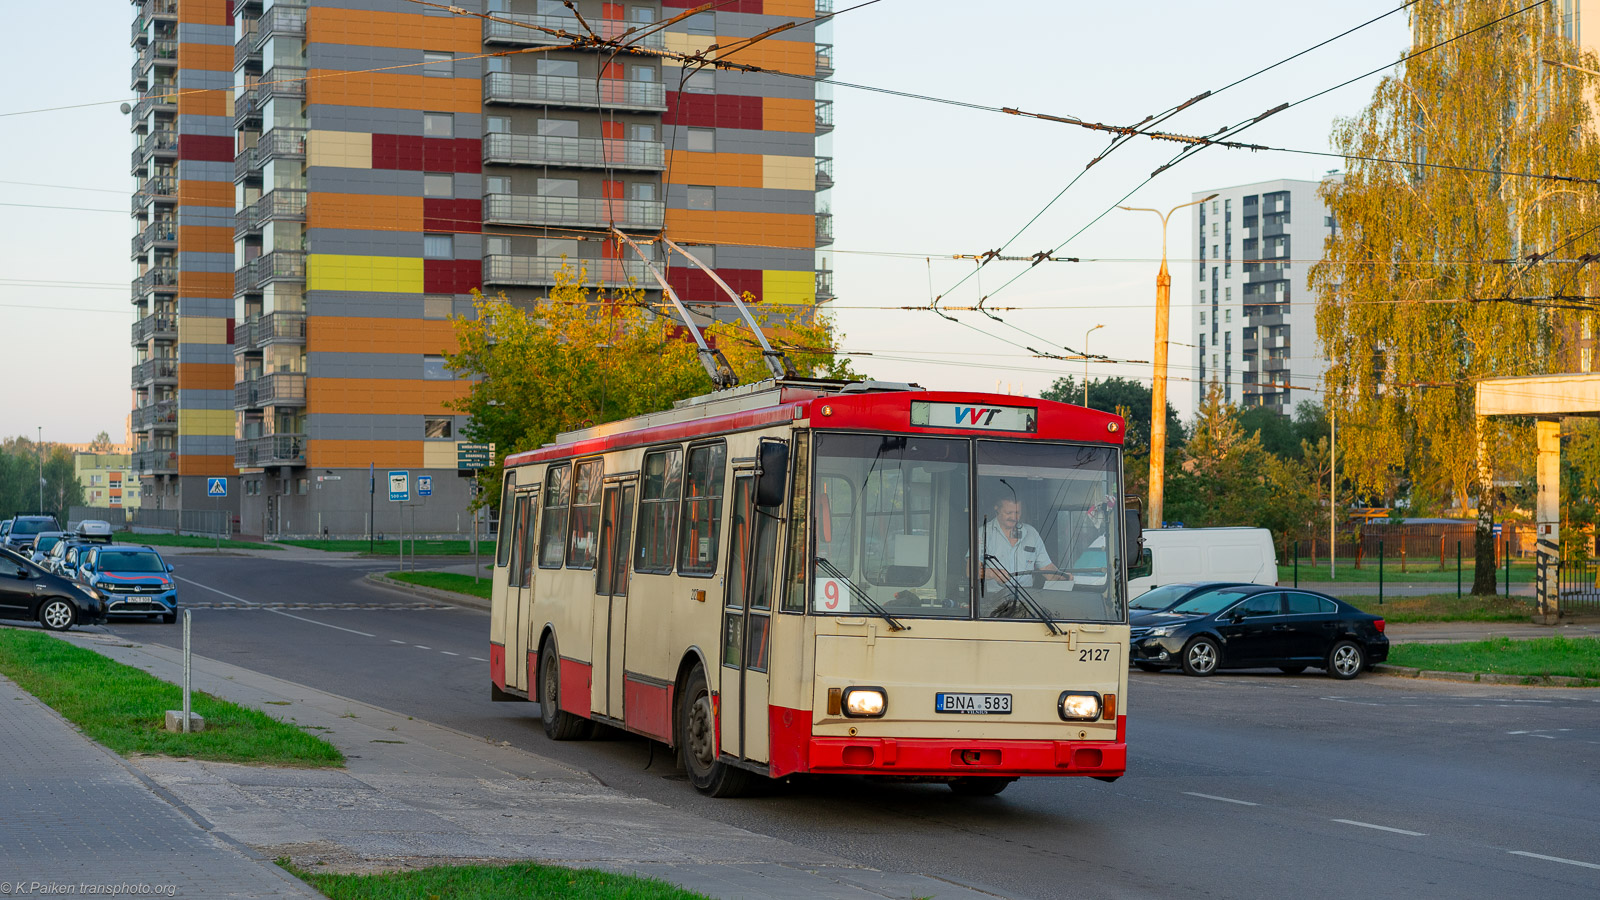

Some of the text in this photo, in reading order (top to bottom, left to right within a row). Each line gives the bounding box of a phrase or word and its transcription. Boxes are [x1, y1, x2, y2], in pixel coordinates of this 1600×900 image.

[955, 406, 1002, 426] VVT
[824, 580, 839, 610] 9
[1079, 648, 1110, 662] 2127
[945, 696, 1008, 710] BNA 583
